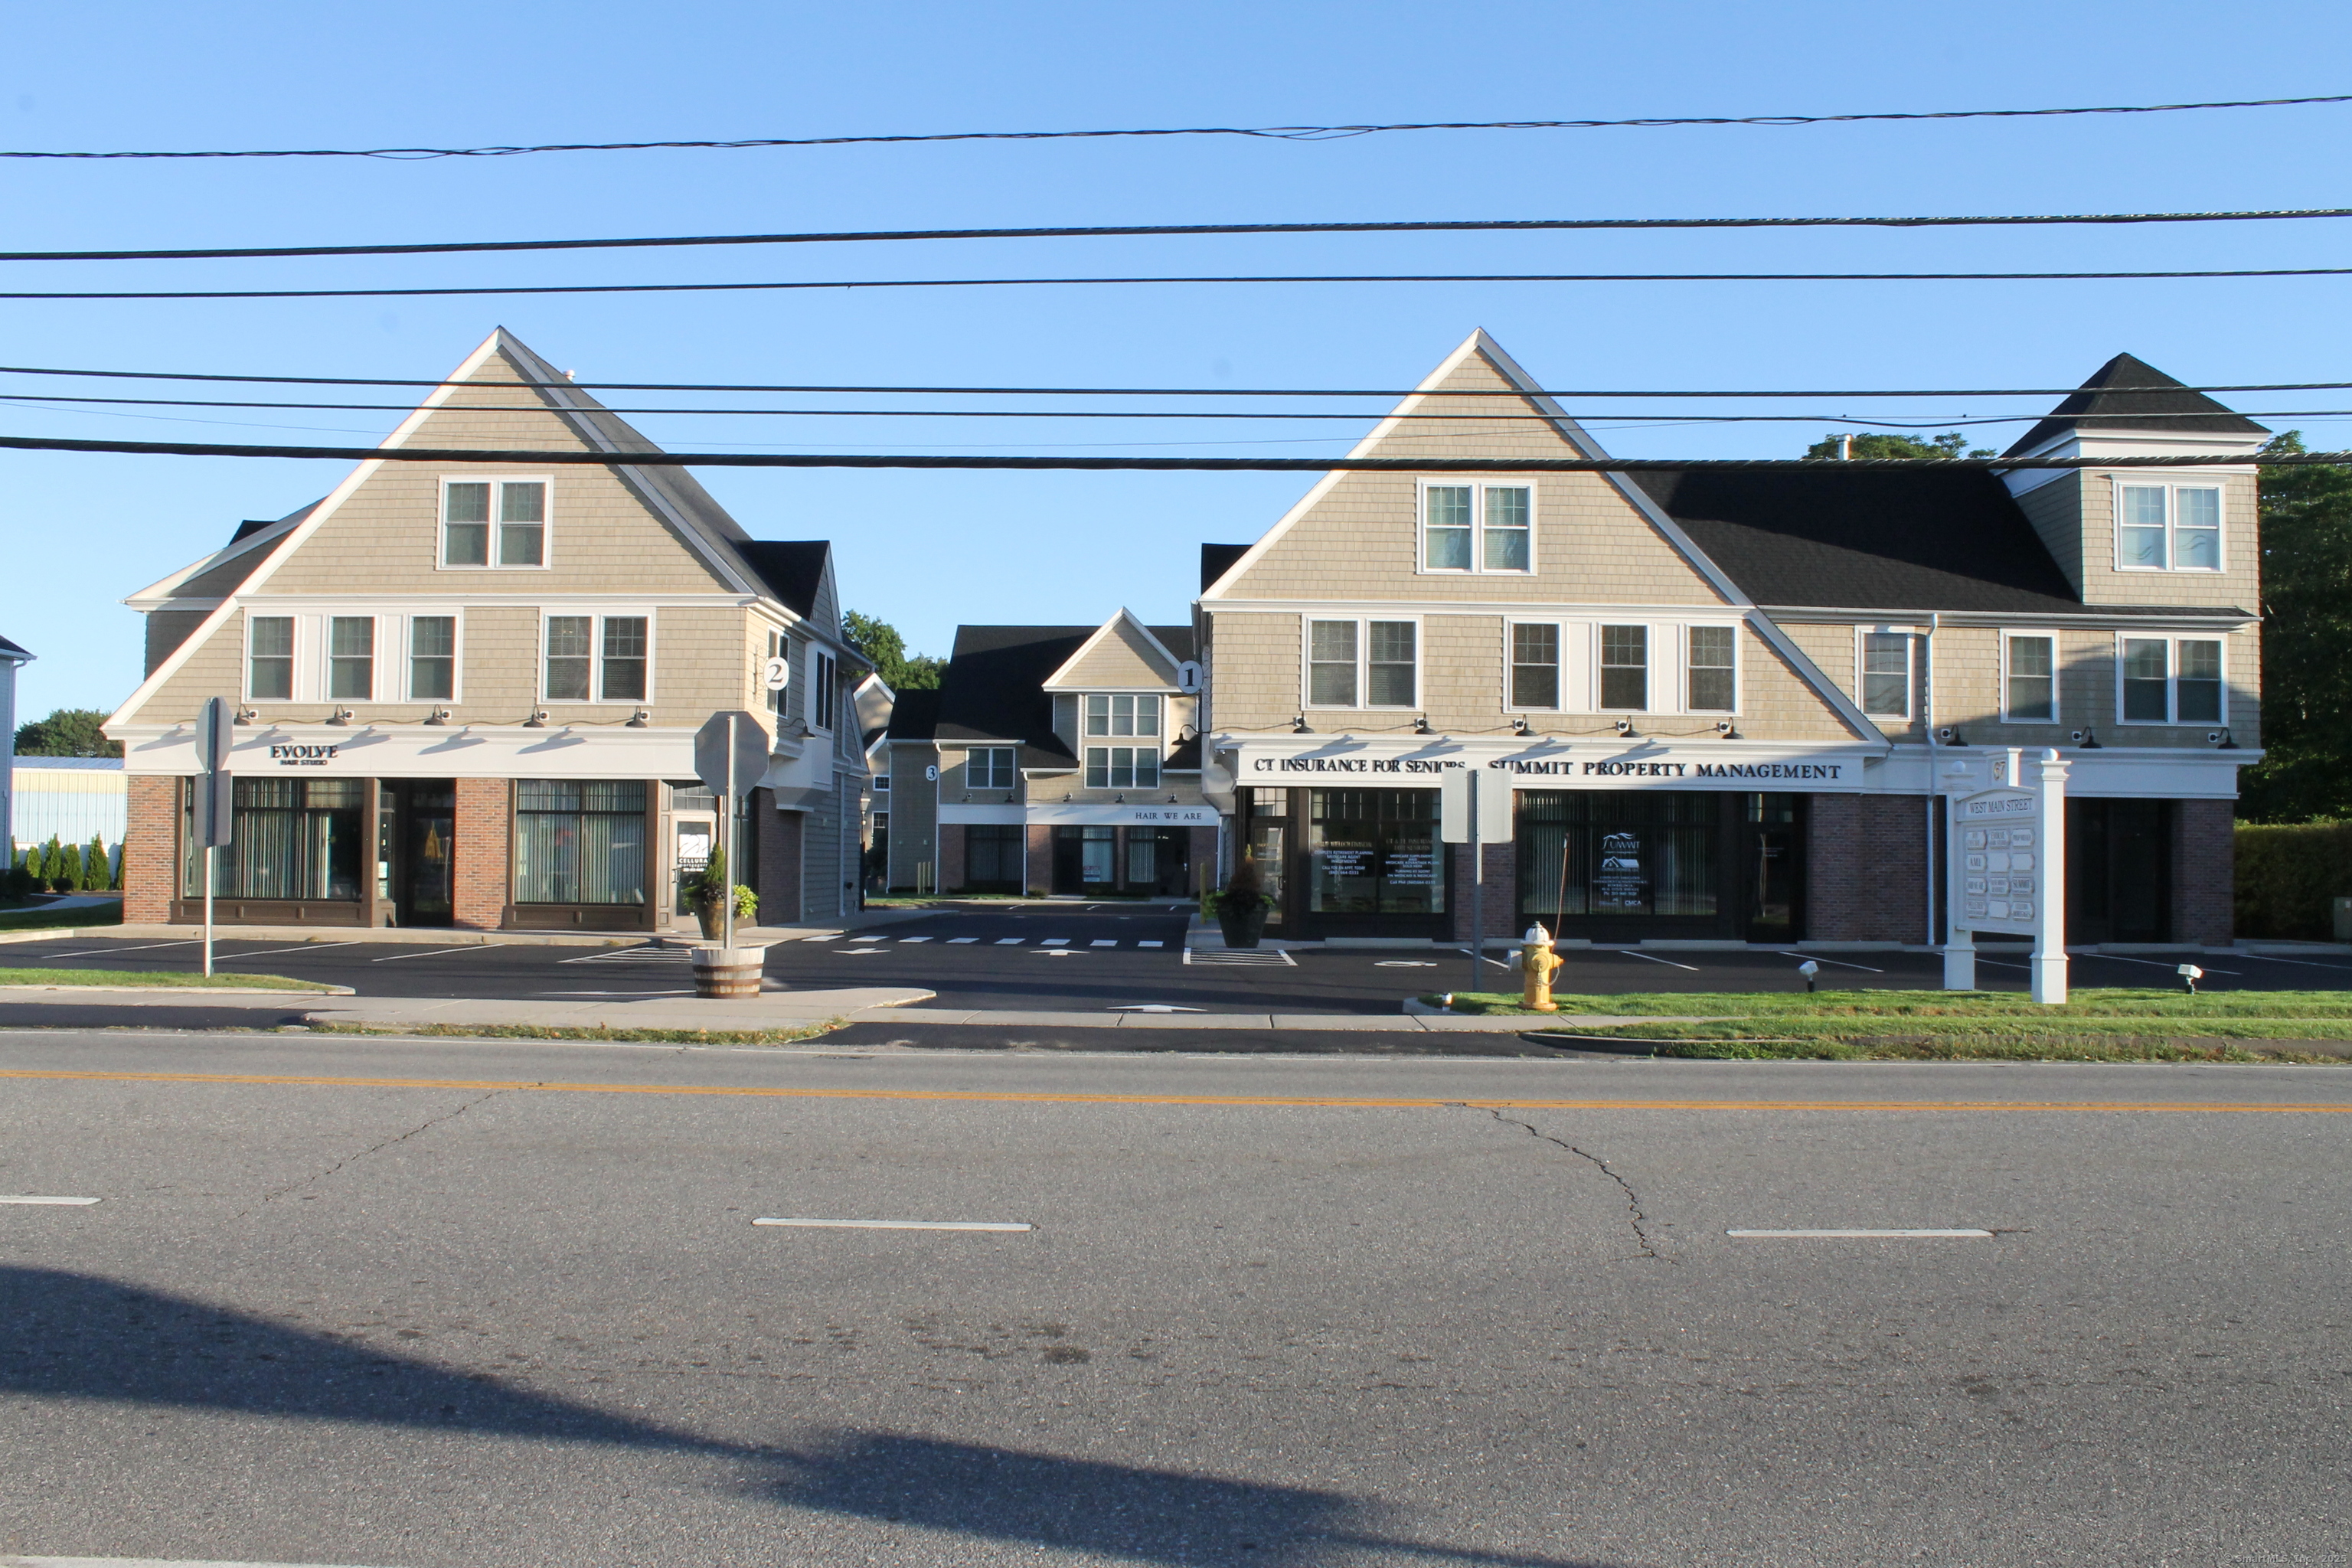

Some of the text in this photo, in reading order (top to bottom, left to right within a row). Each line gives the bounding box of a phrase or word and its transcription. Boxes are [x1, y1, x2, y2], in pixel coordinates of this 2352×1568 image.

[768, 663, 784, 683] 2
[1184, 668, 1195, 687] 1
[270, 745, 338, 759] EVOLVE
[928, 767, 936, 779] 3
[1254, 758, 1275, 772] CT
[1279, 759, 1368, 773] INSURANCE
[1371, 760, 1402, 773] FOR
[1488, 760, 1841, 779] SUMMIT PROPERTY MANAGEMENT
[1969, 798, 2033, 814] WEST MAIN STREET
